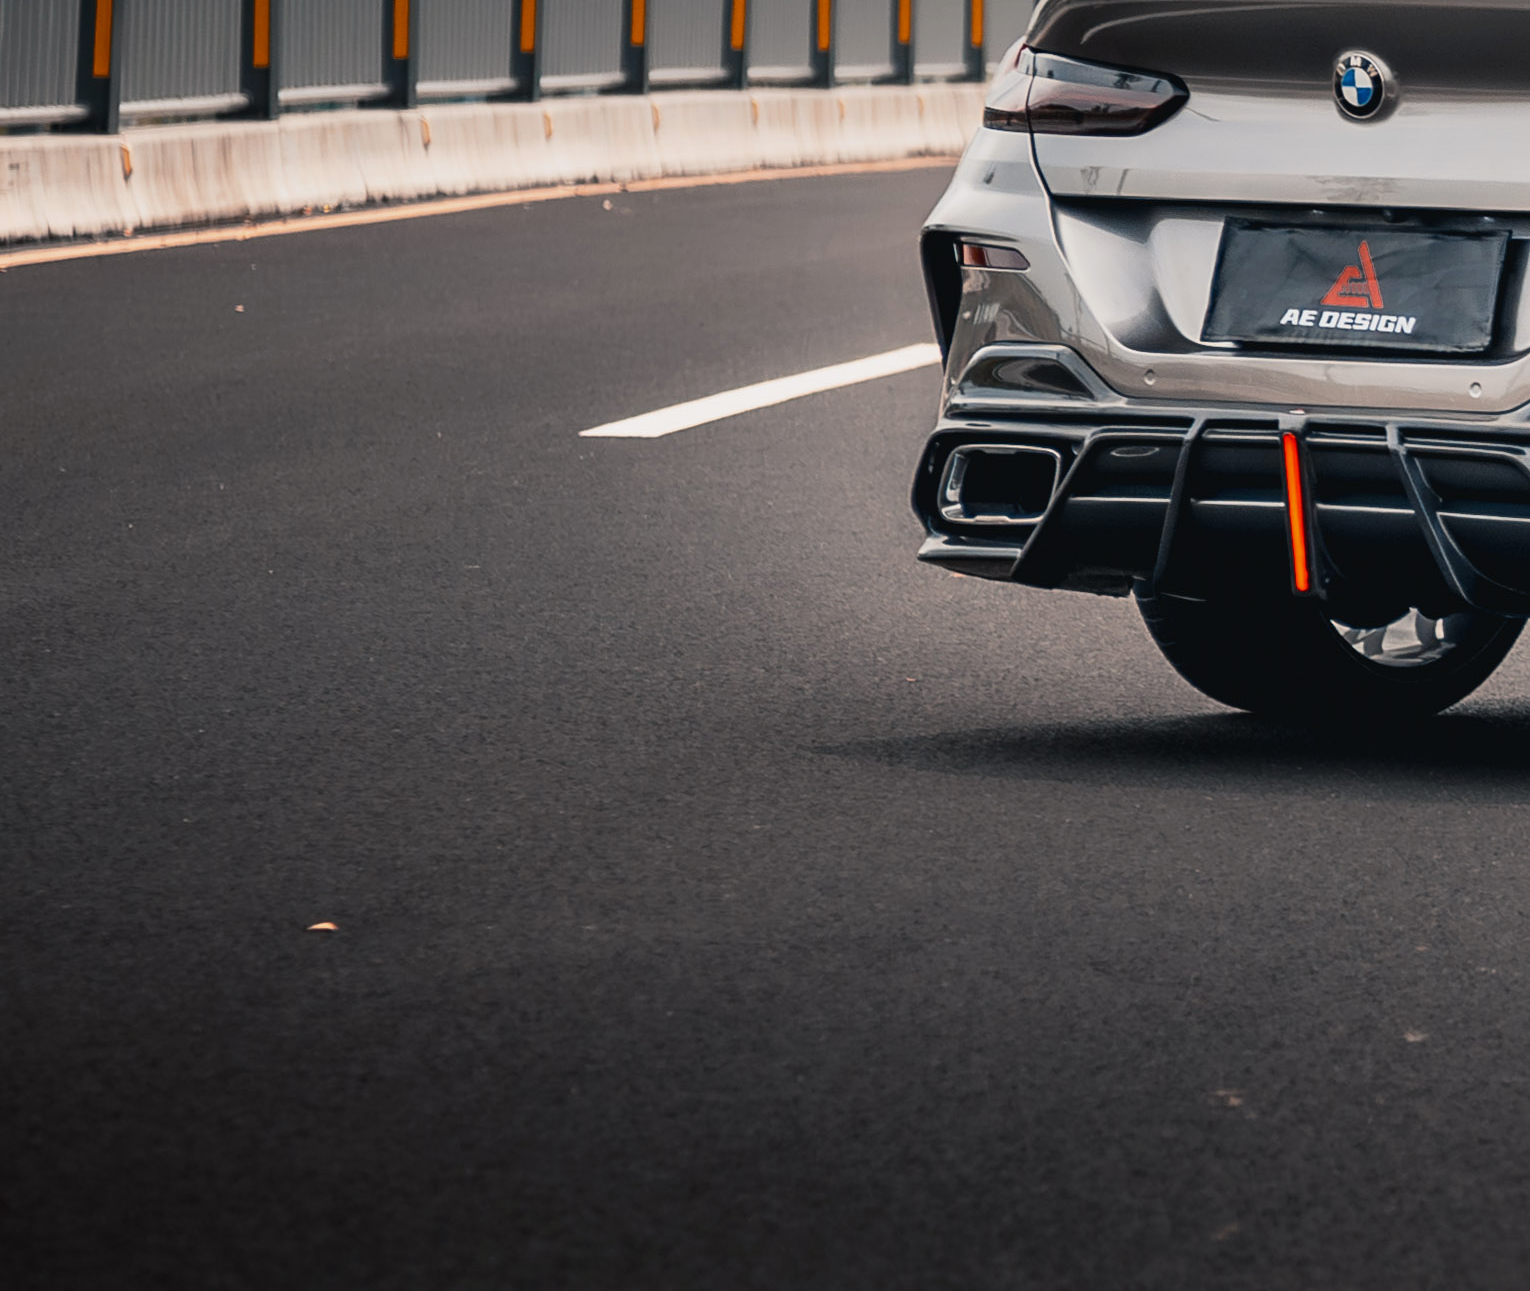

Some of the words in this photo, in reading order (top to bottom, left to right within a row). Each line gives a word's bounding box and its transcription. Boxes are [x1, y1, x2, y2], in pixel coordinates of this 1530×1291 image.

[1336, 55, 1378, 77] BMW
[1280, 308, 1318, 327] AE
[1319, 311, 1417, 334] DESIGN
